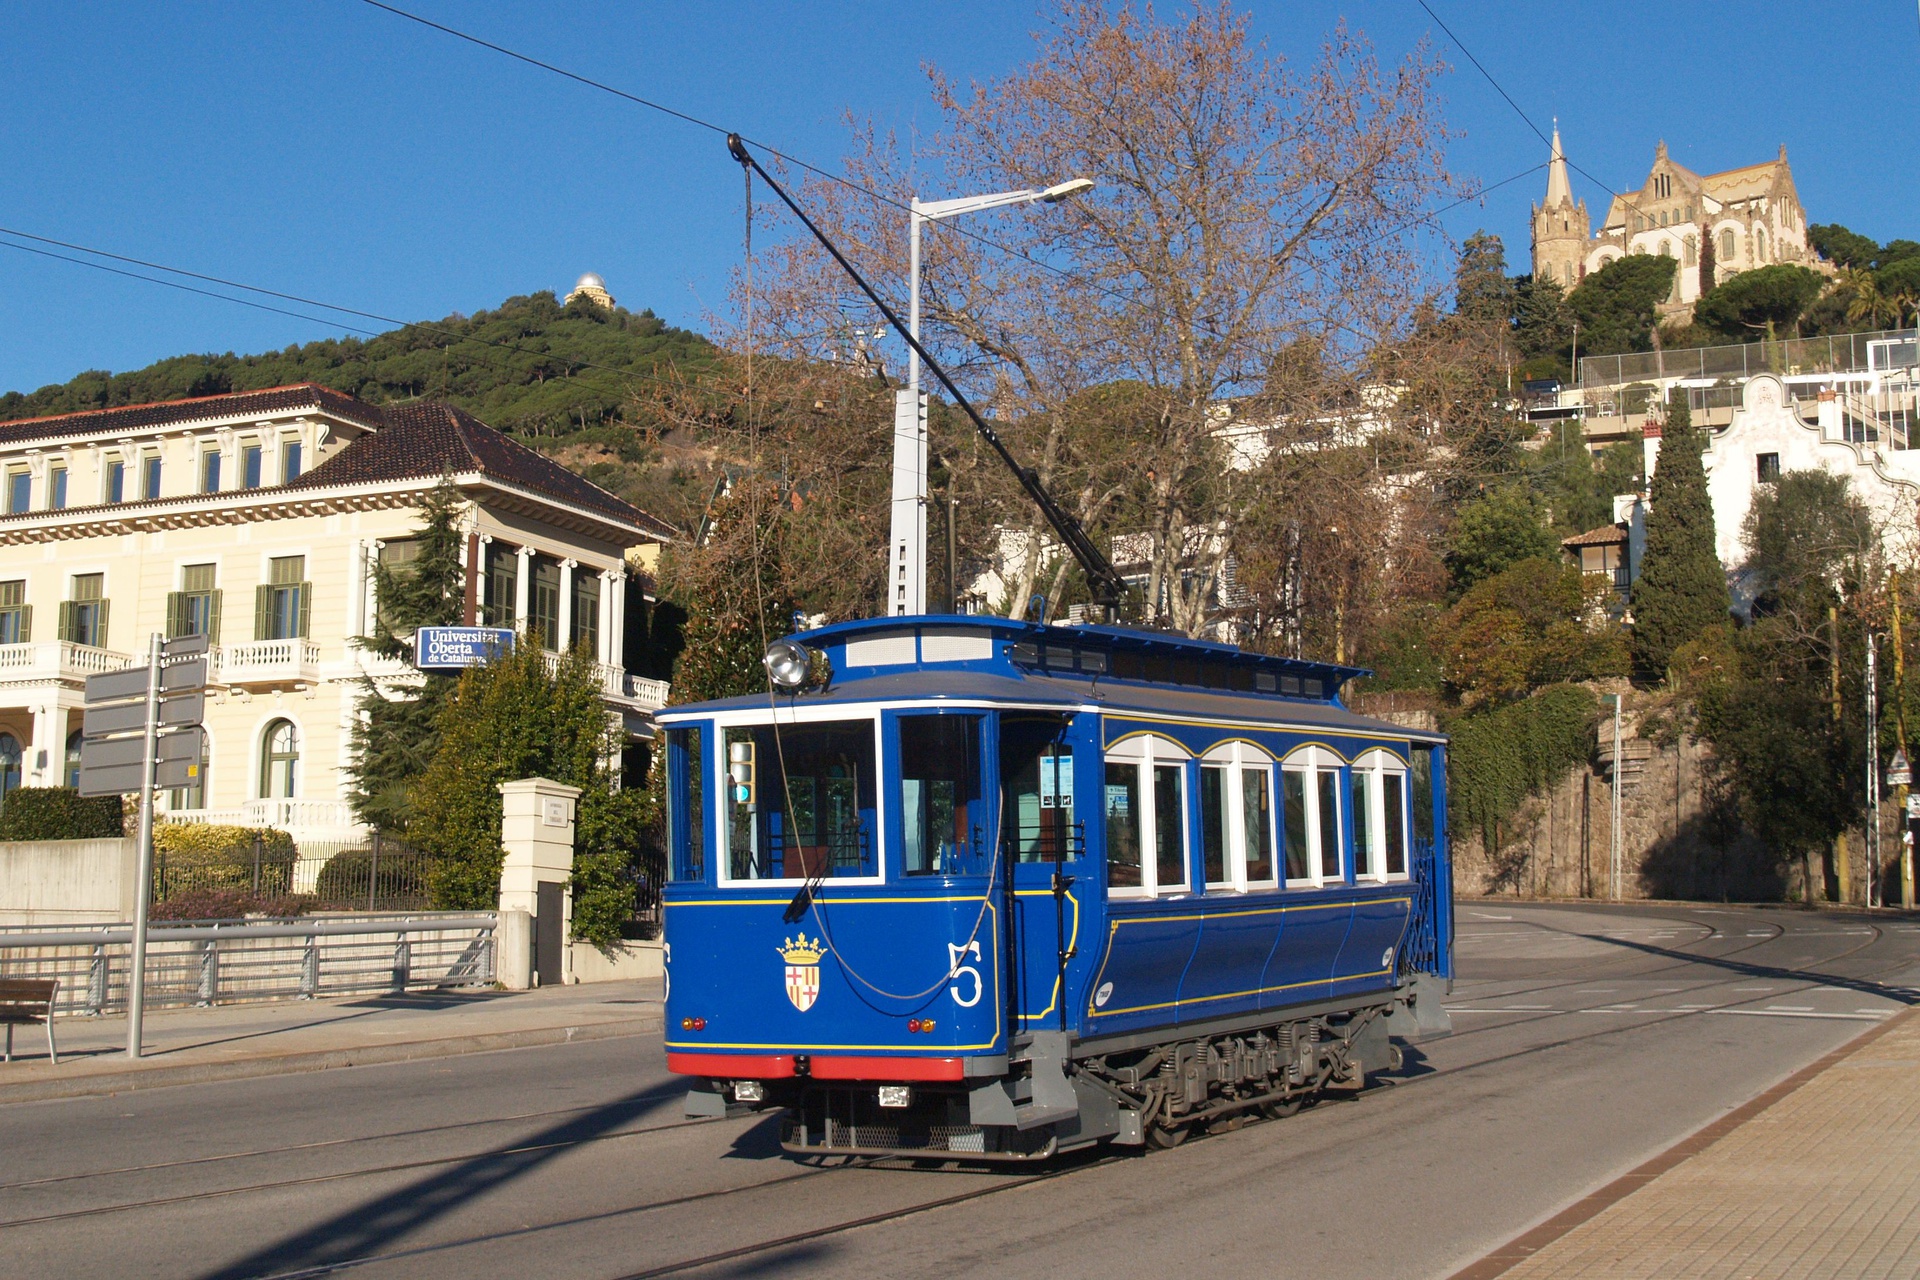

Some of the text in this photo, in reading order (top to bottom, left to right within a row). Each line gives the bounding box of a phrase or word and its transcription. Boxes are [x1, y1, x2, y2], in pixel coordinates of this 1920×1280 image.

[429, 630, 500, 643] Universitat
[428, 642, 473, 654] Oberta
[428, 654, 439, 663] de
[948, 940, 982, 1007] 5
